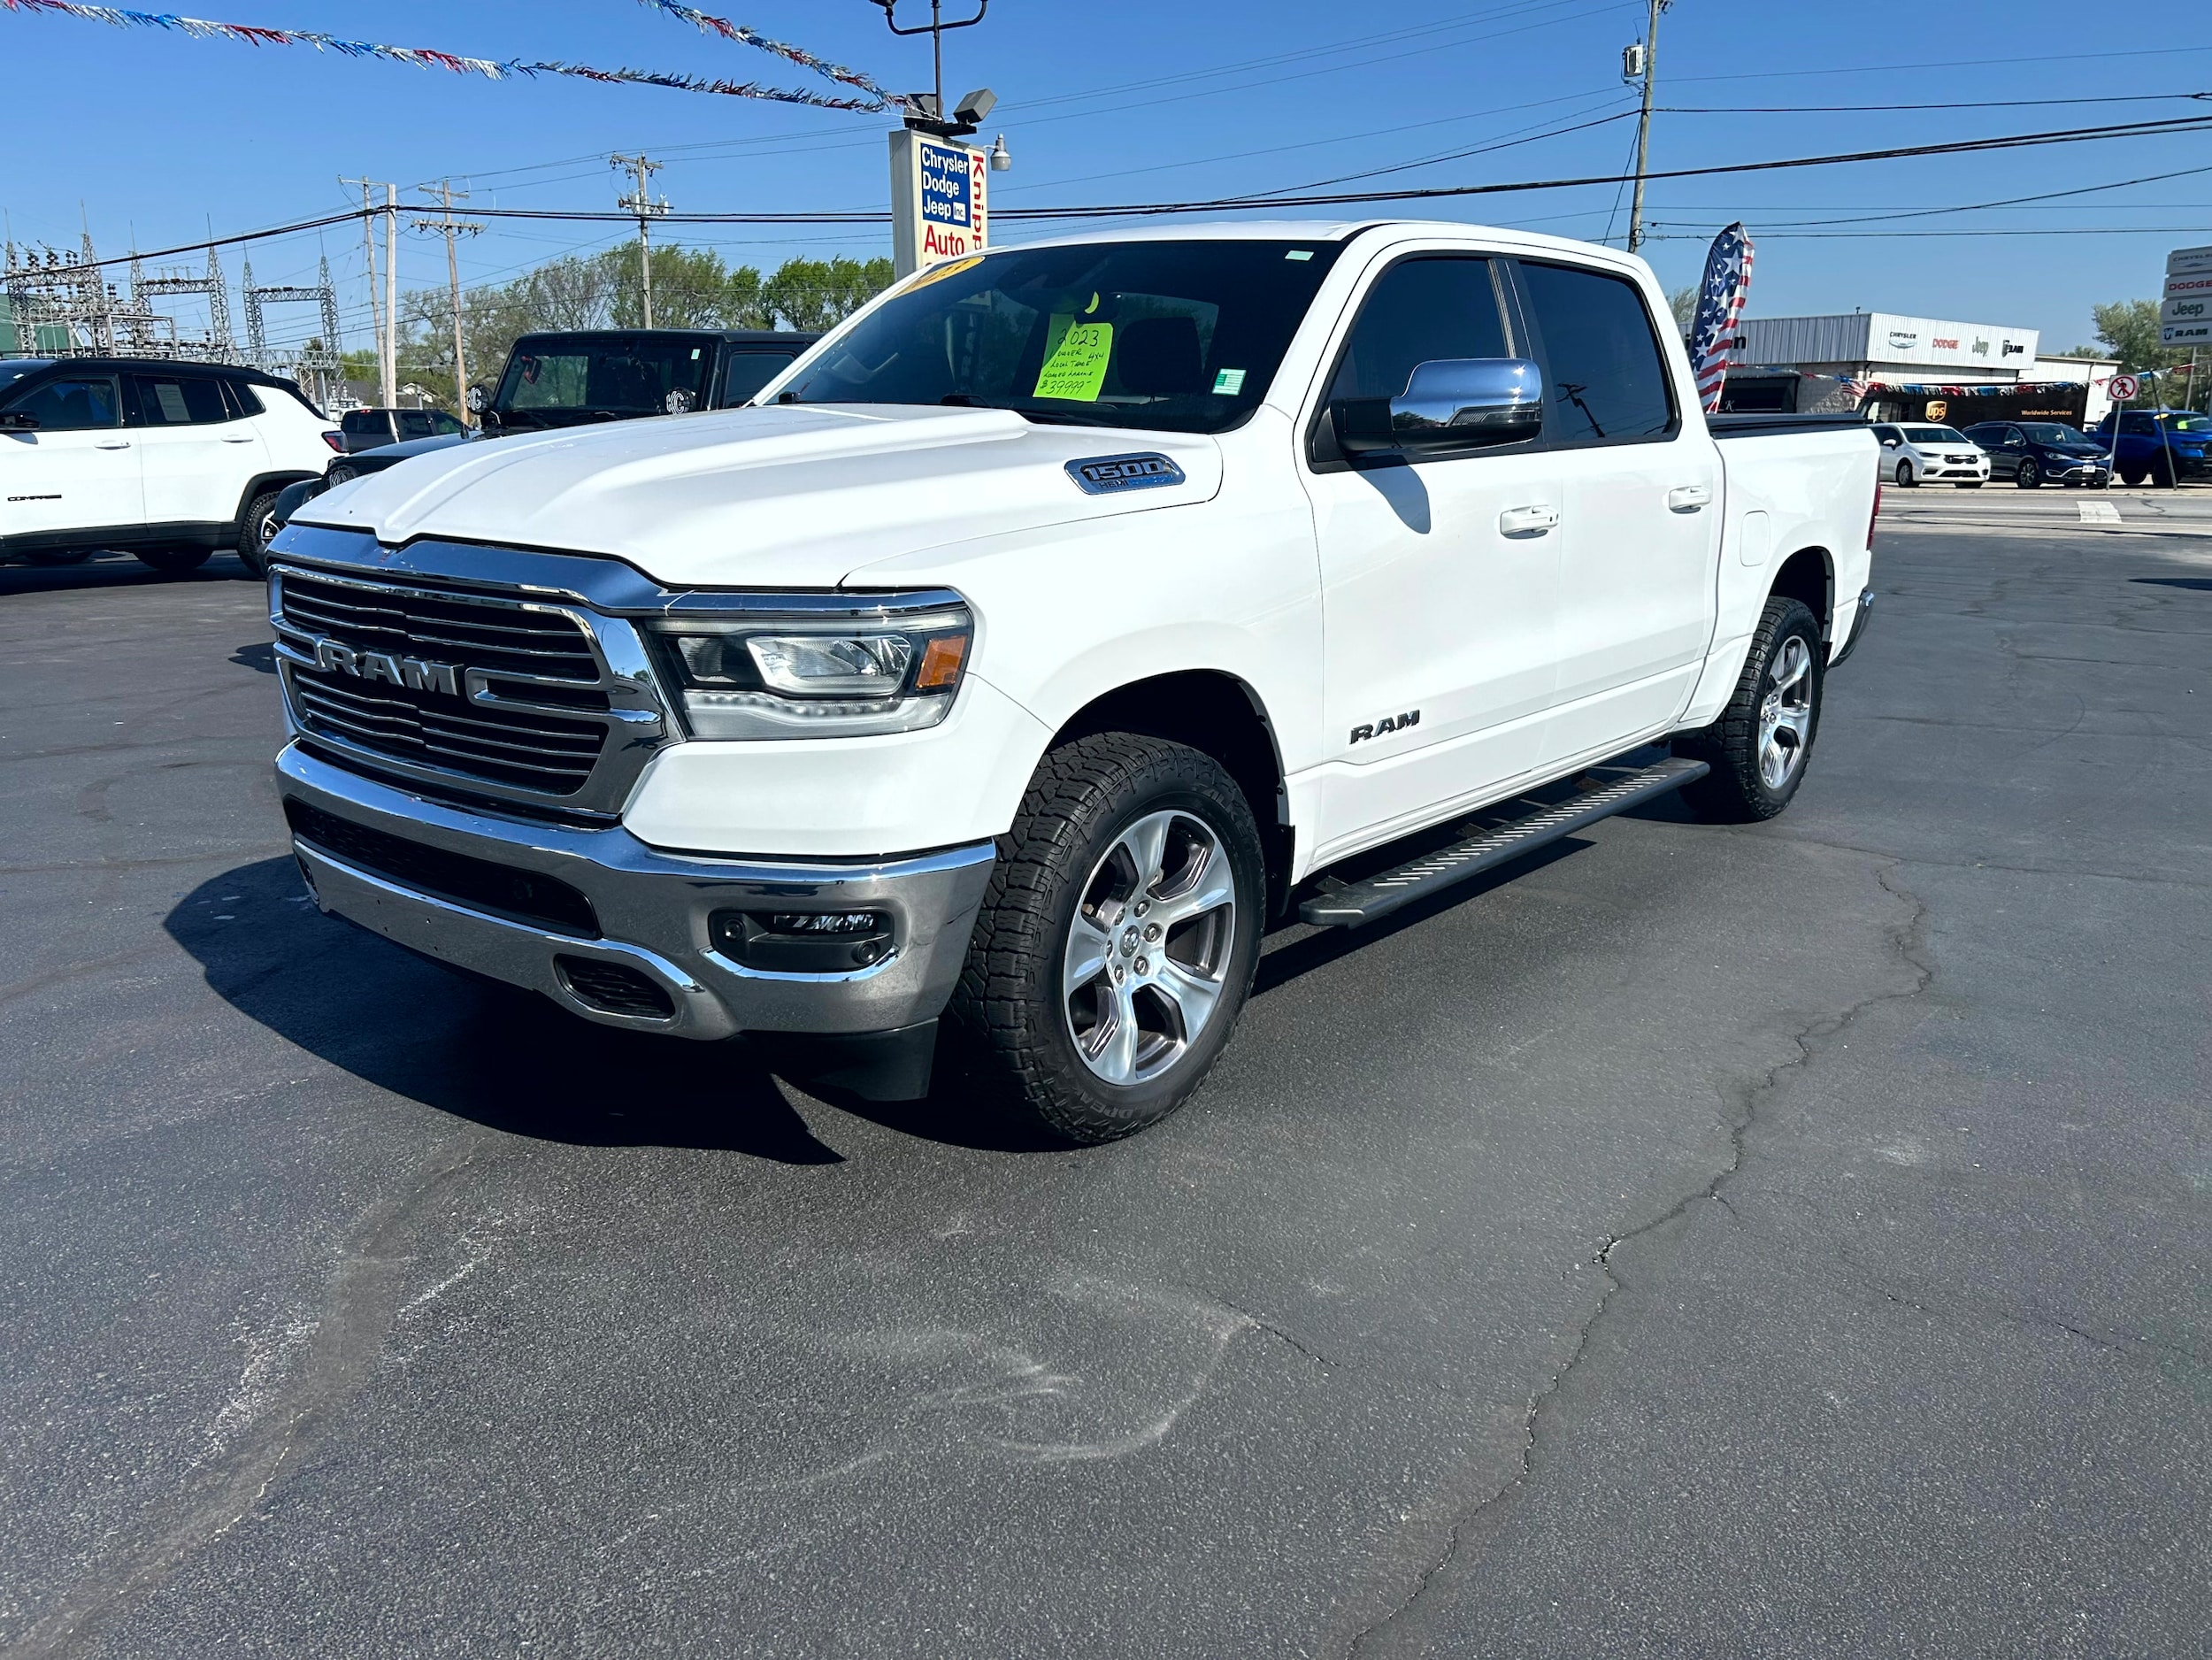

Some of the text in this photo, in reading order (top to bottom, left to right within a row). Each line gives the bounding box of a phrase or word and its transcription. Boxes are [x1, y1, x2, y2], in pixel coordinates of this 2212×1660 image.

[921, 146, 969, 175] Chrysler
[922, 171, 960, 198] Dodge
[923, 196, 965, 220] Jeep Inc.
[924, 225, 965, 257] Auto
[2173, 253, 2212, 262] CHRYSLE
[2169, 280, 2212, 291] DODGE
[2172, 302, 2204, 317] Jeep
[1057, 328, 1100, 347] 2023
[1889, 331, 1916, 340] CHRYSLER
[2175, 328, 2208, 337] RAM
[1932, 338, 1959, 350] DODGE
[1972, 336, 1989, 357] Jeep
[666, 390, 685, 415] KC
[1927, 406, 1945, 419] ups
[1084, 461, 1166, 480] 1500
[1099, 479, 1129, 488] HEMI
[320, 638, 466, 696] RAM
[1349, 709, 1420, 744] RAM
